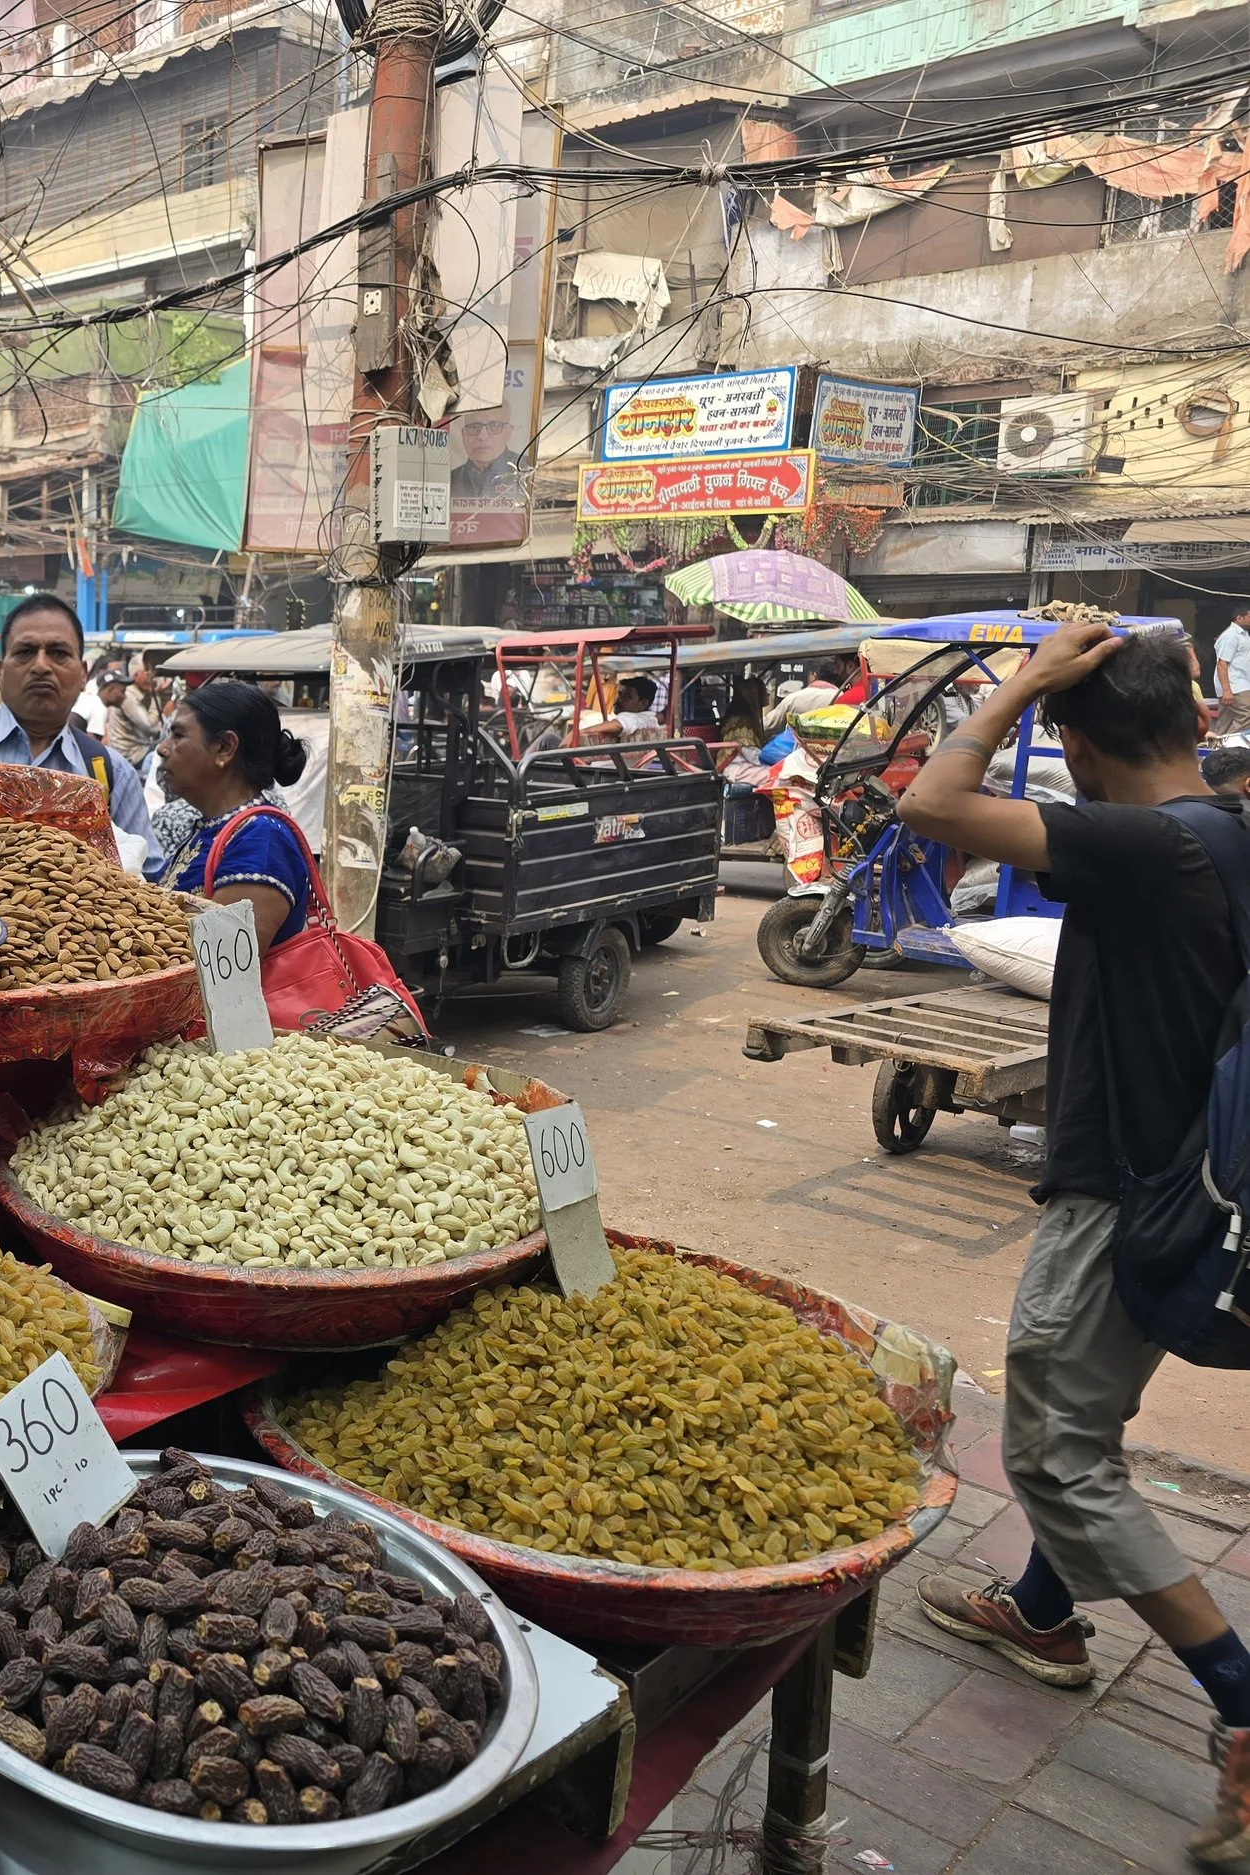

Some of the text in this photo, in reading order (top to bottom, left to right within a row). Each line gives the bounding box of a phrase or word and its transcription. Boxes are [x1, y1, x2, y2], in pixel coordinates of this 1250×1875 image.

[724, 387, 766, 403] अगरबत्ती
[617, 408, 696, 436] शानदार
[704, 474, 734, 494] पुजन
[737, 469, 767, 490] गिफ्ट
[770, 477, 790, 499] पैक
[413, 641, 444, 654] YATRI
[968, 624, 1023, 643] EWA
[199, 928, 253, 986] 960
[541, 1121, 586, 1178] 600
